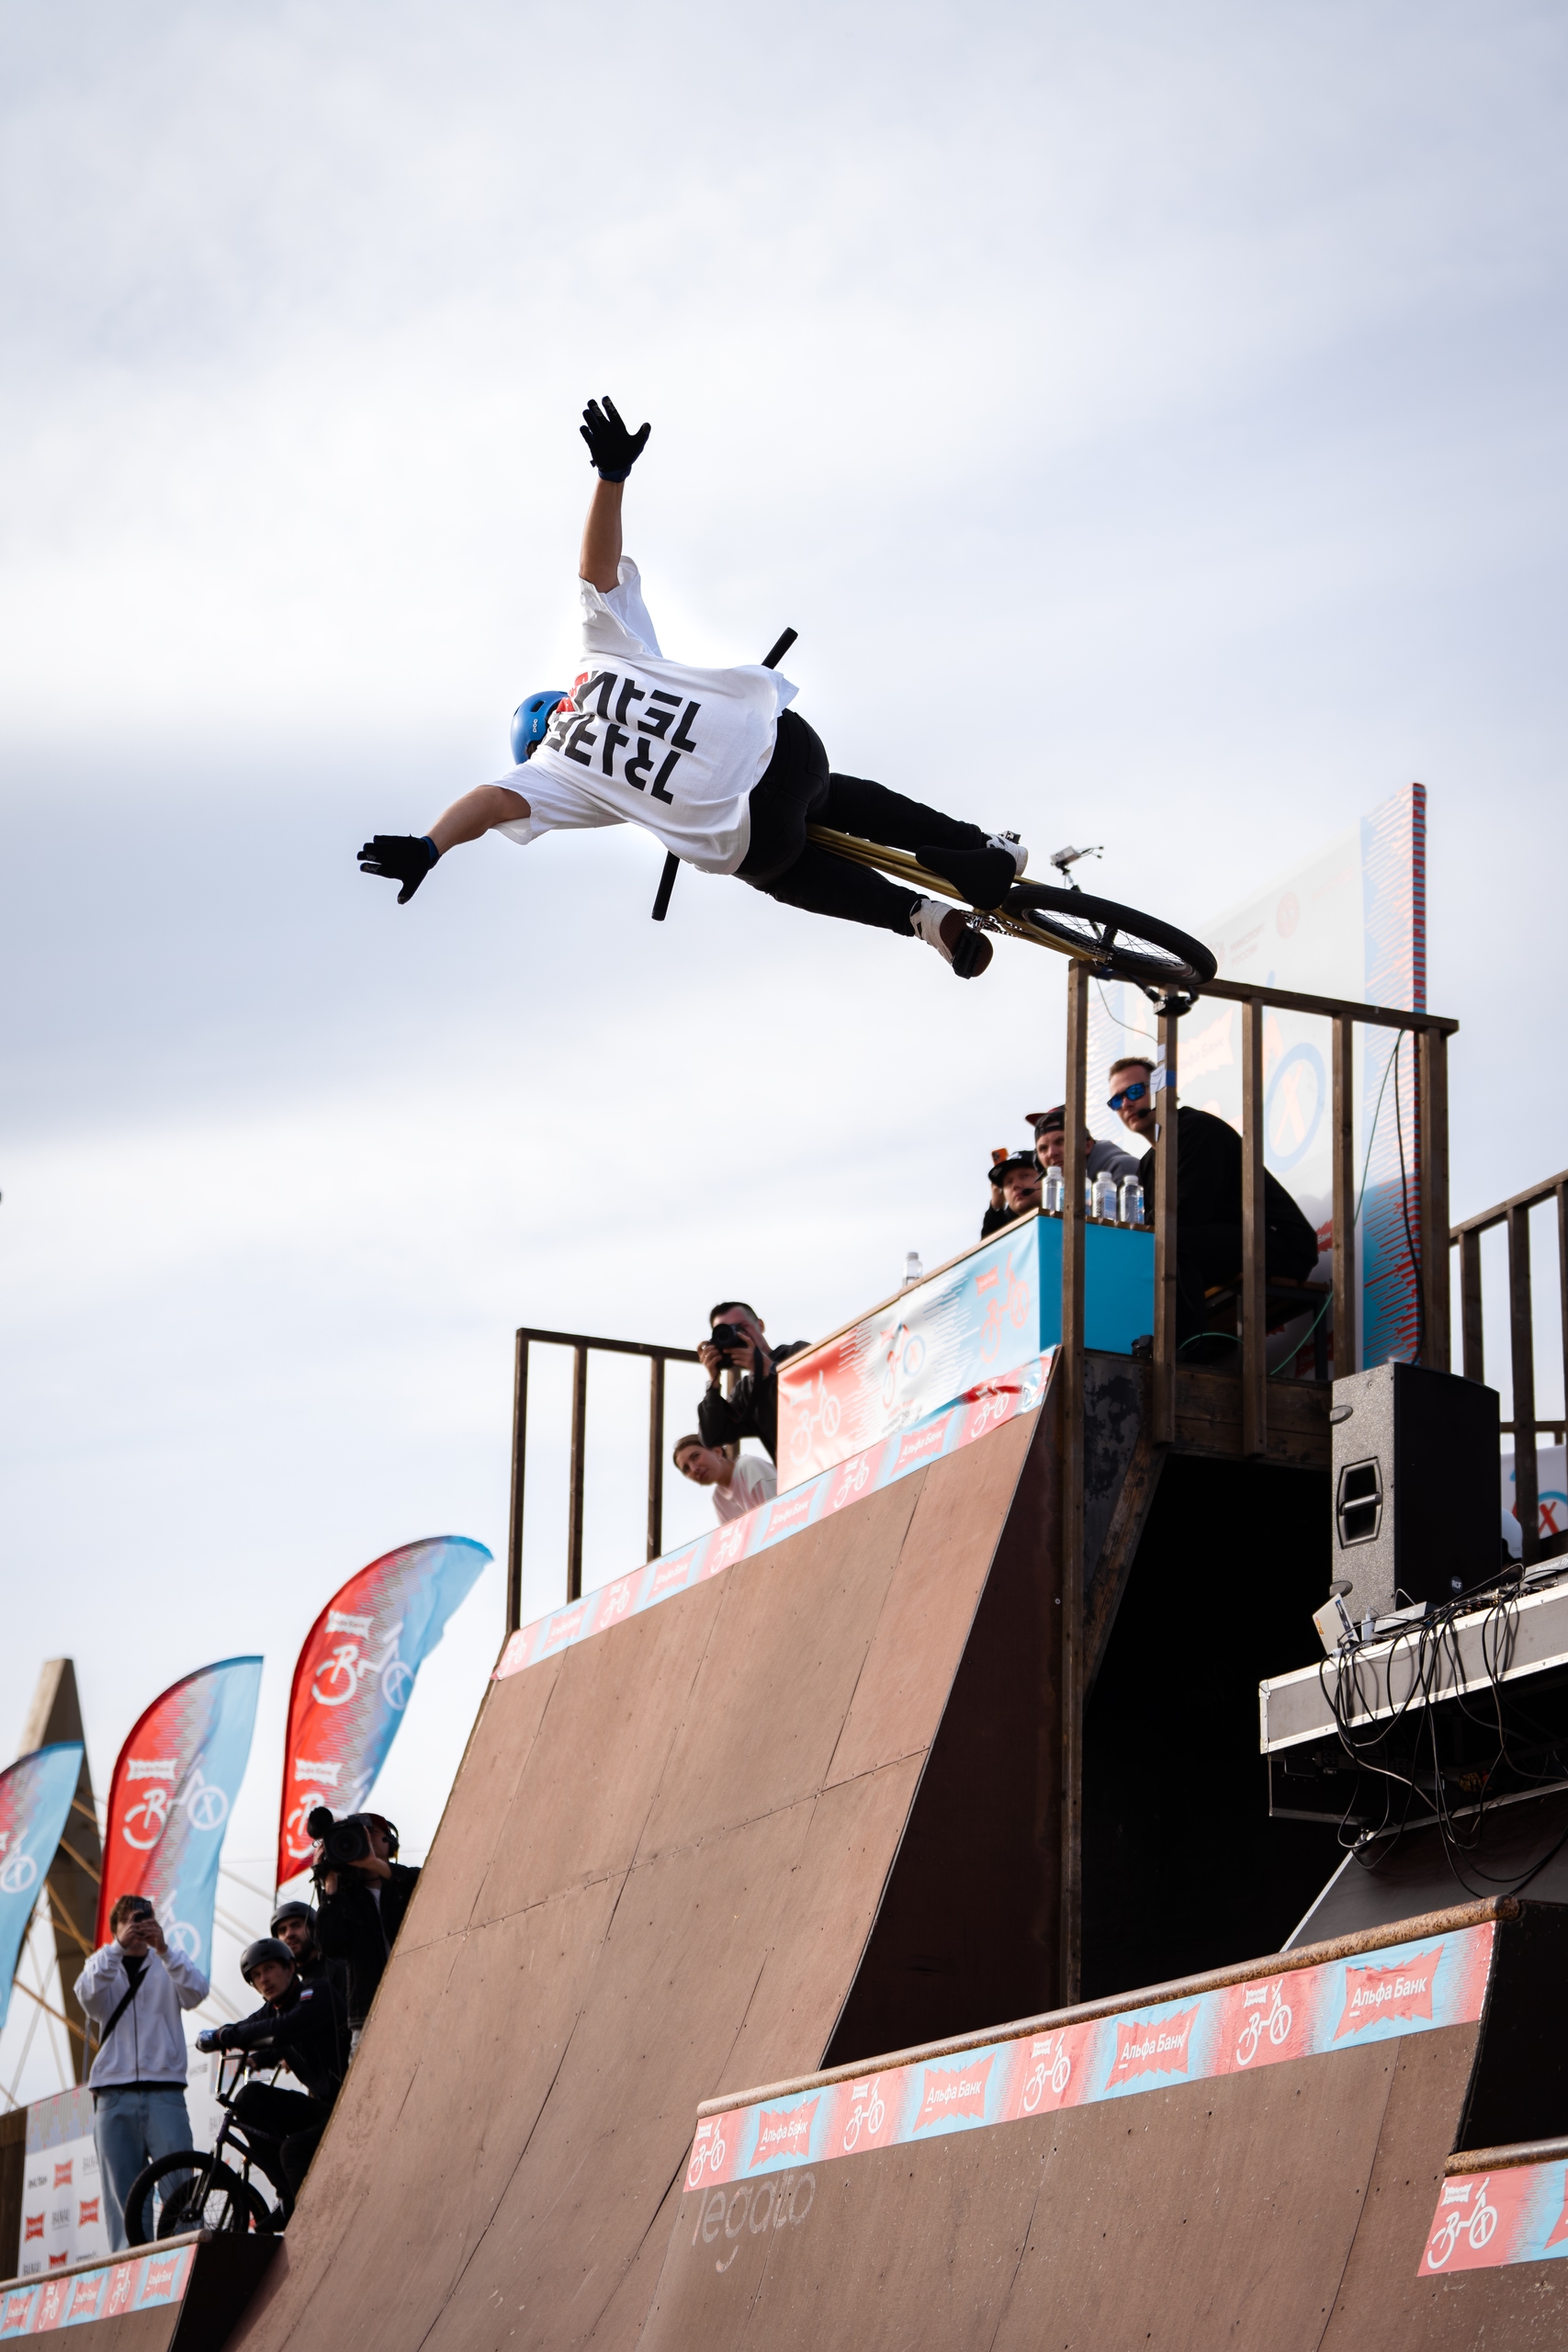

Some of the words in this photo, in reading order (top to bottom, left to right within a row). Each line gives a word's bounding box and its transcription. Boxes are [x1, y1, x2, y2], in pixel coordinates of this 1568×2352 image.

[1351, 1982, 1392, 2009] Альфа
[1393, 1977, 1427, 1998] Банк
[1121, 2038, 1156, 2062] Альфа
[1156, 2033, 1185, 2053] Банк
[927, 2083, 957, 2106] Альфа
[957, 2080, 983, 2098] Банк
[761, 2124, 787, 2144] Альфа
[788, 2120, 808, 2138] Банк
